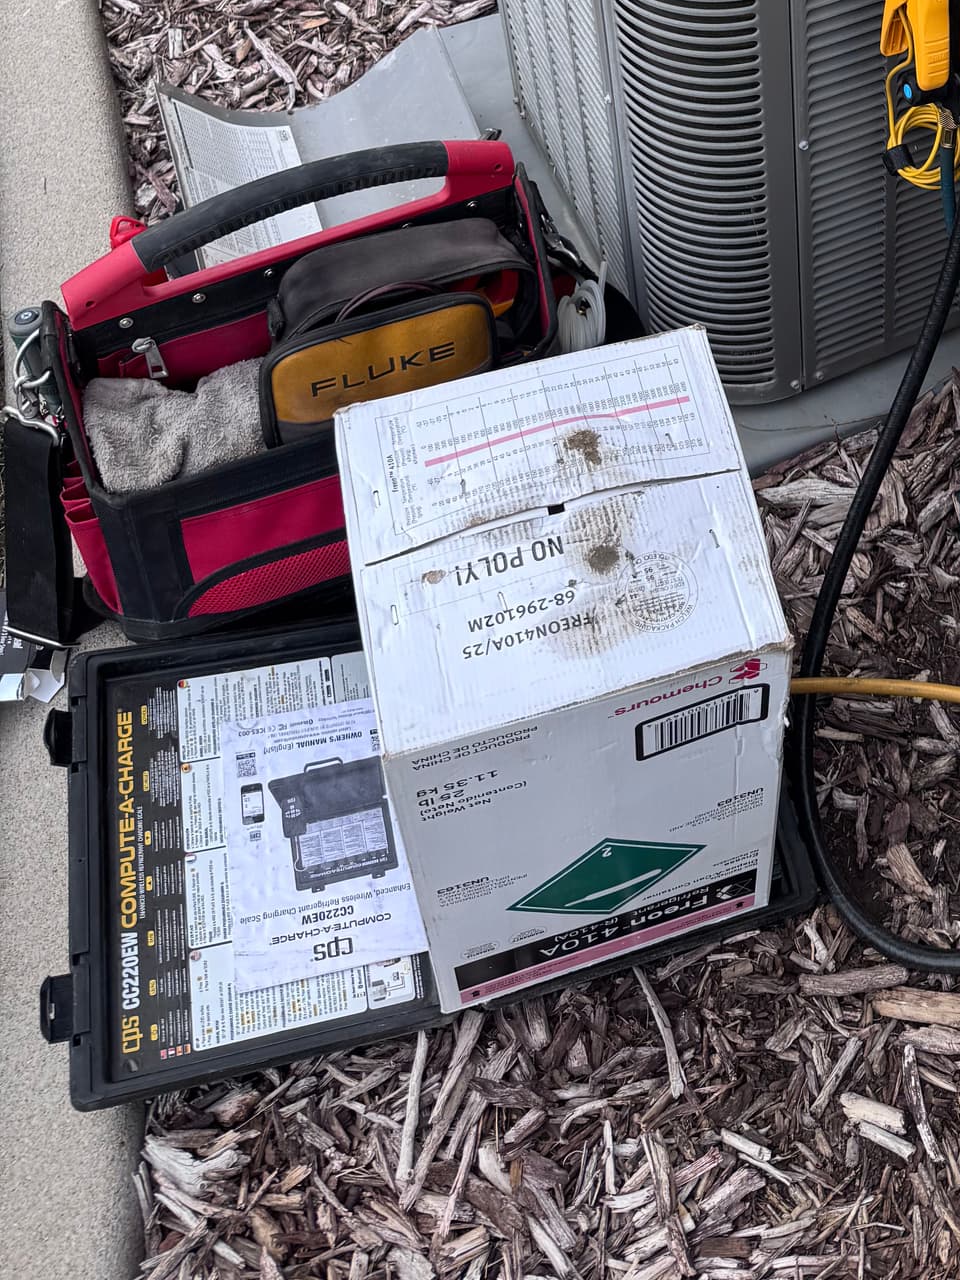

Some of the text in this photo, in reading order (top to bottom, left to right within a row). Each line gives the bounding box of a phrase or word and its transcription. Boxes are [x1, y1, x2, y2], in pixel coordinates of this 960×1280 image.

[309, 341, 456, 397] FLUKE
[454, 534, 564, 586] NO POLY!
[466, 589, 575, 633] 68-296102M
[674, 604, 693, 625] WELCH
[461, 611, 591, 660] FREON410A/25
[262, 730, 363, 754] OWNER'S MANUAL (English)
[410, 724, 537, 766] PRODUCTO DE CHINA
[411, 732, 530, 772] PRODUCT OF CHINA
[415, 768, 498, 800] 11.35 kg
[417, 788, 465, 809] 25 lb
[419, 779, 527, 817] (Contenido Neto)
[420, 797, 491, 823] Net Weight
[601, 845, 612, 858] 2
[340, 889, 373, 904] Wireless
[436, 875, 489, 895] UN3163
[262, 904, 297, 921] Charging
[297, 895, 340, 913] Refrigerant
[632, 885, 708, 916] Refrigerant
[239, 913, 261, 926] Scale
[300, 904, 354, 926] CC220EW
[538, 923, 619, 959] 410A
[553, 916, 618, 943] (R-410A)
[120, 929, 140, 1011] CC220EW
